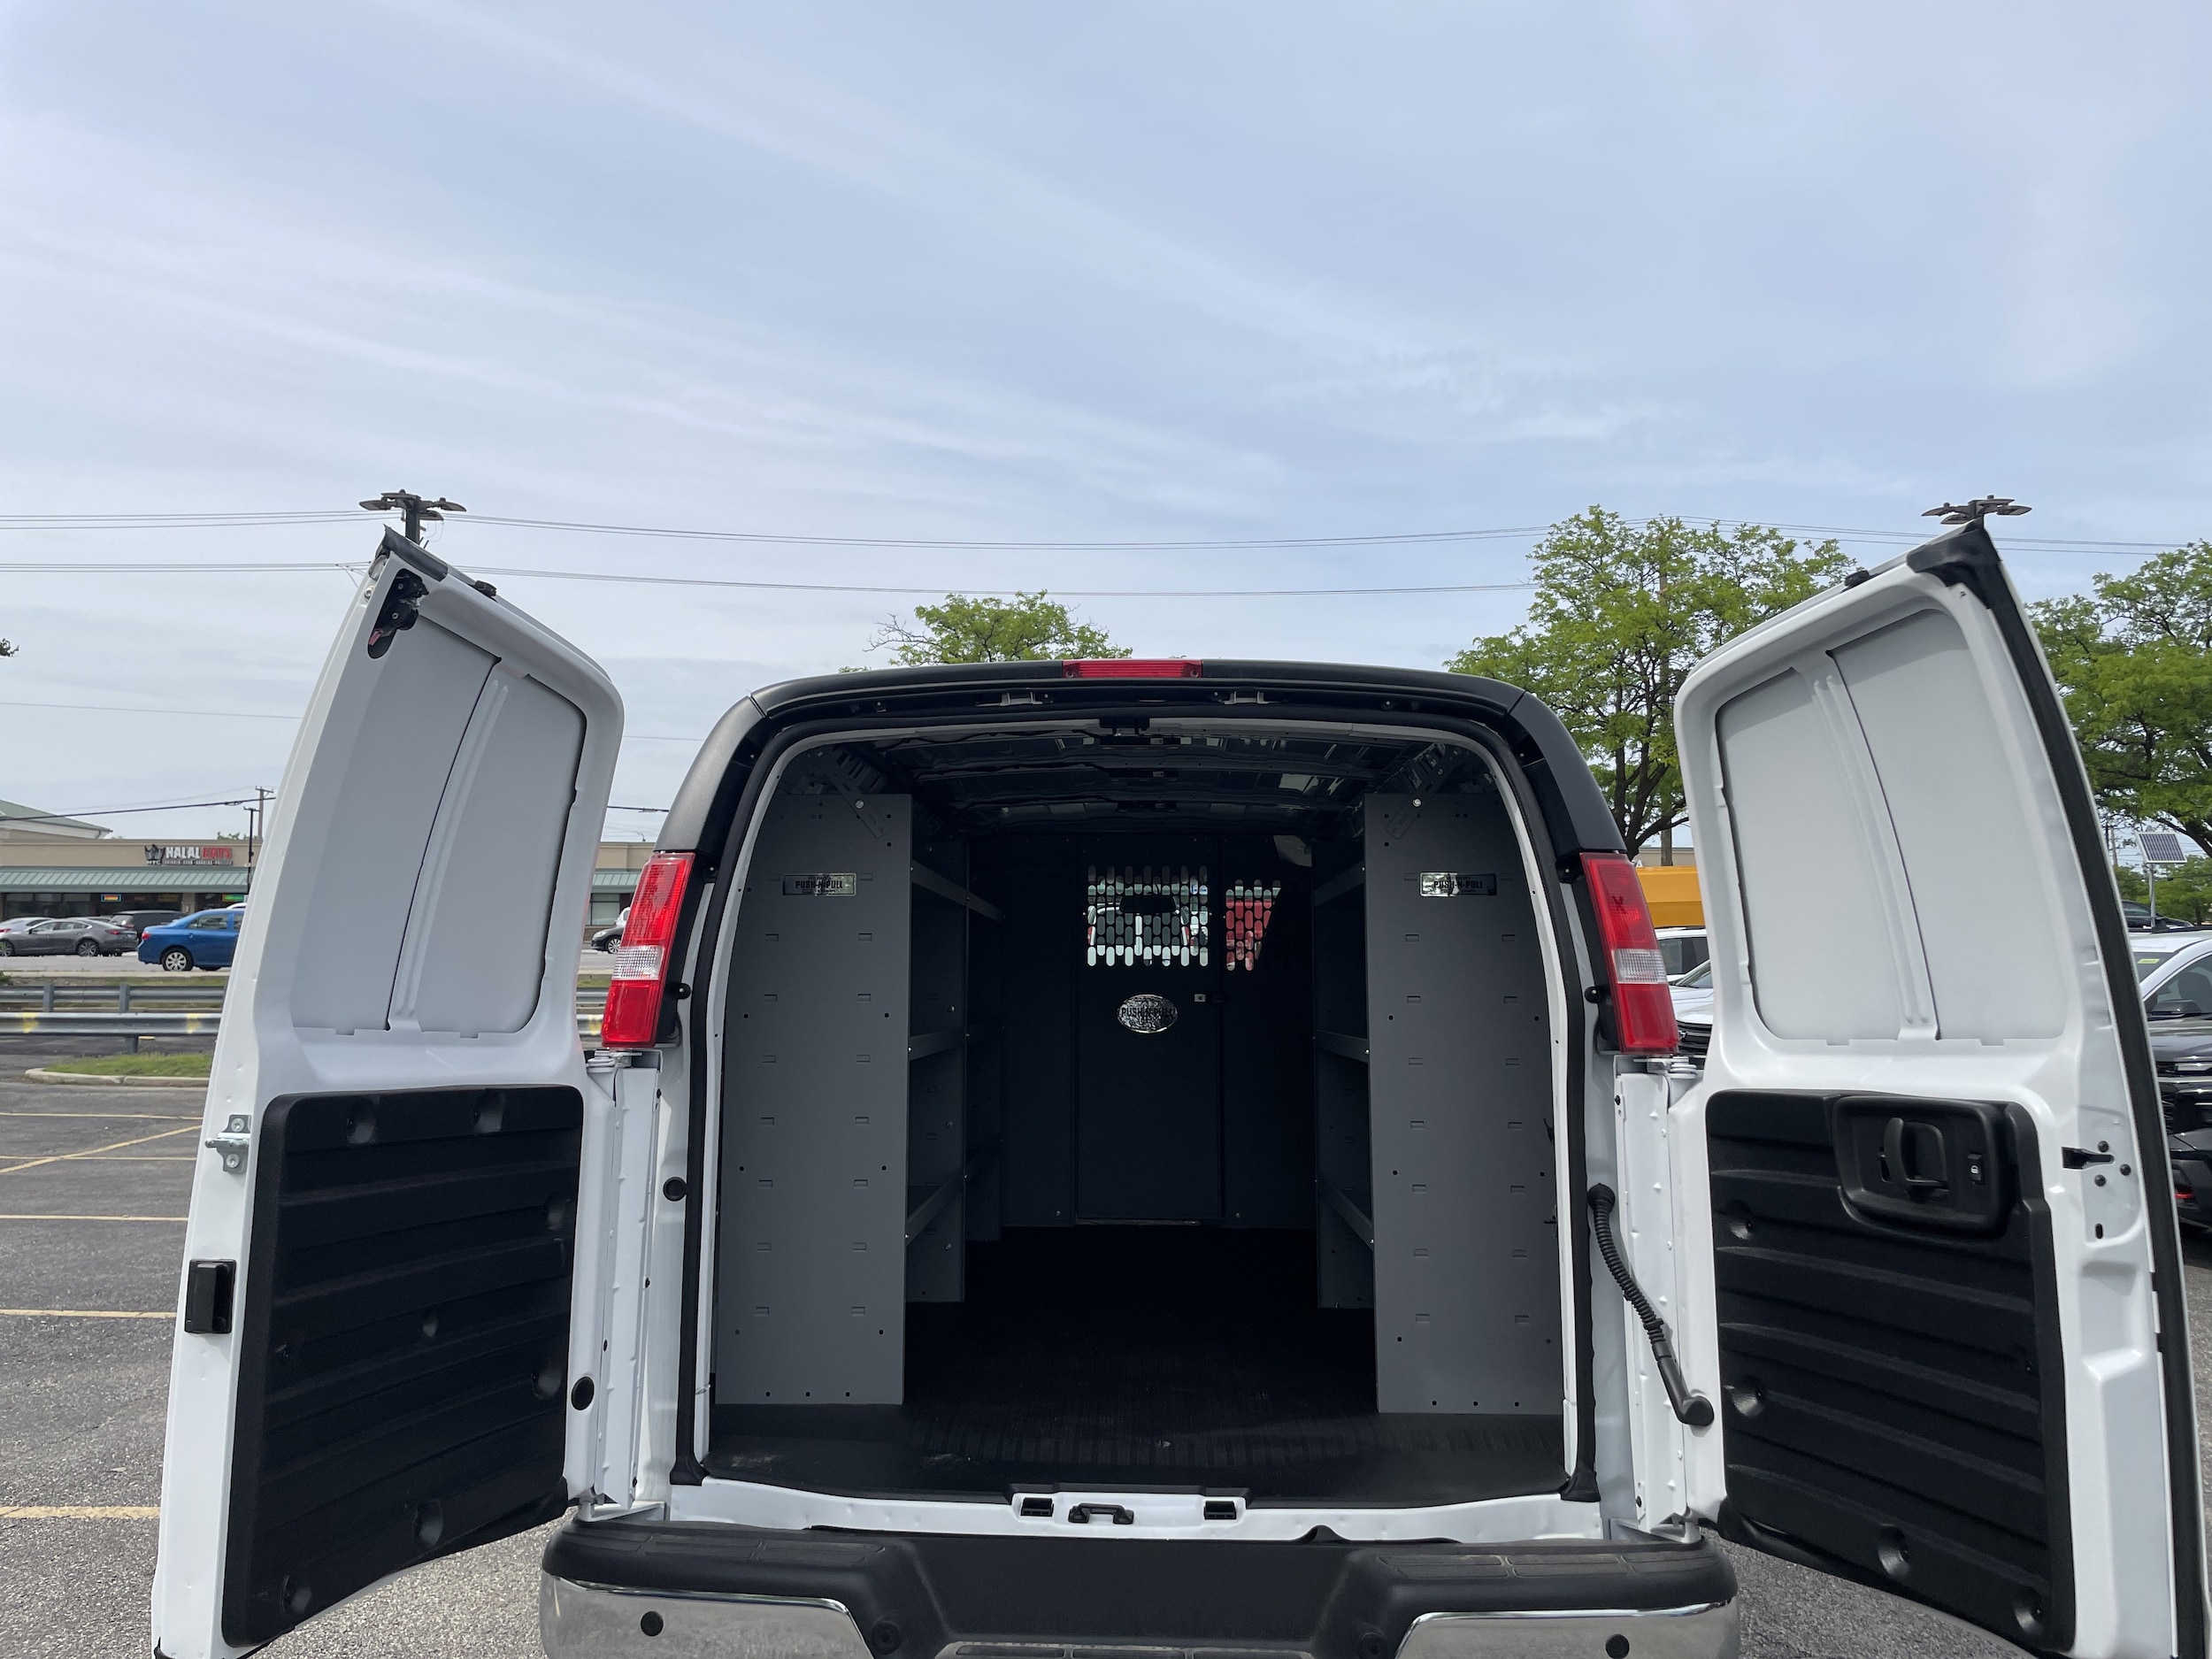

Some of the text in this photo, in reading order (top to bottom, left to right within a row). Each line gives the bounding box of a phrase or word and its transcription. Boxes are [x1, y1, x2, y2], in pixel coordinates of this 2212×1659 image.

[165, 847, 232, 859] HALAL EATS
[795, 880, 843, 889] PUSH-NPULL
